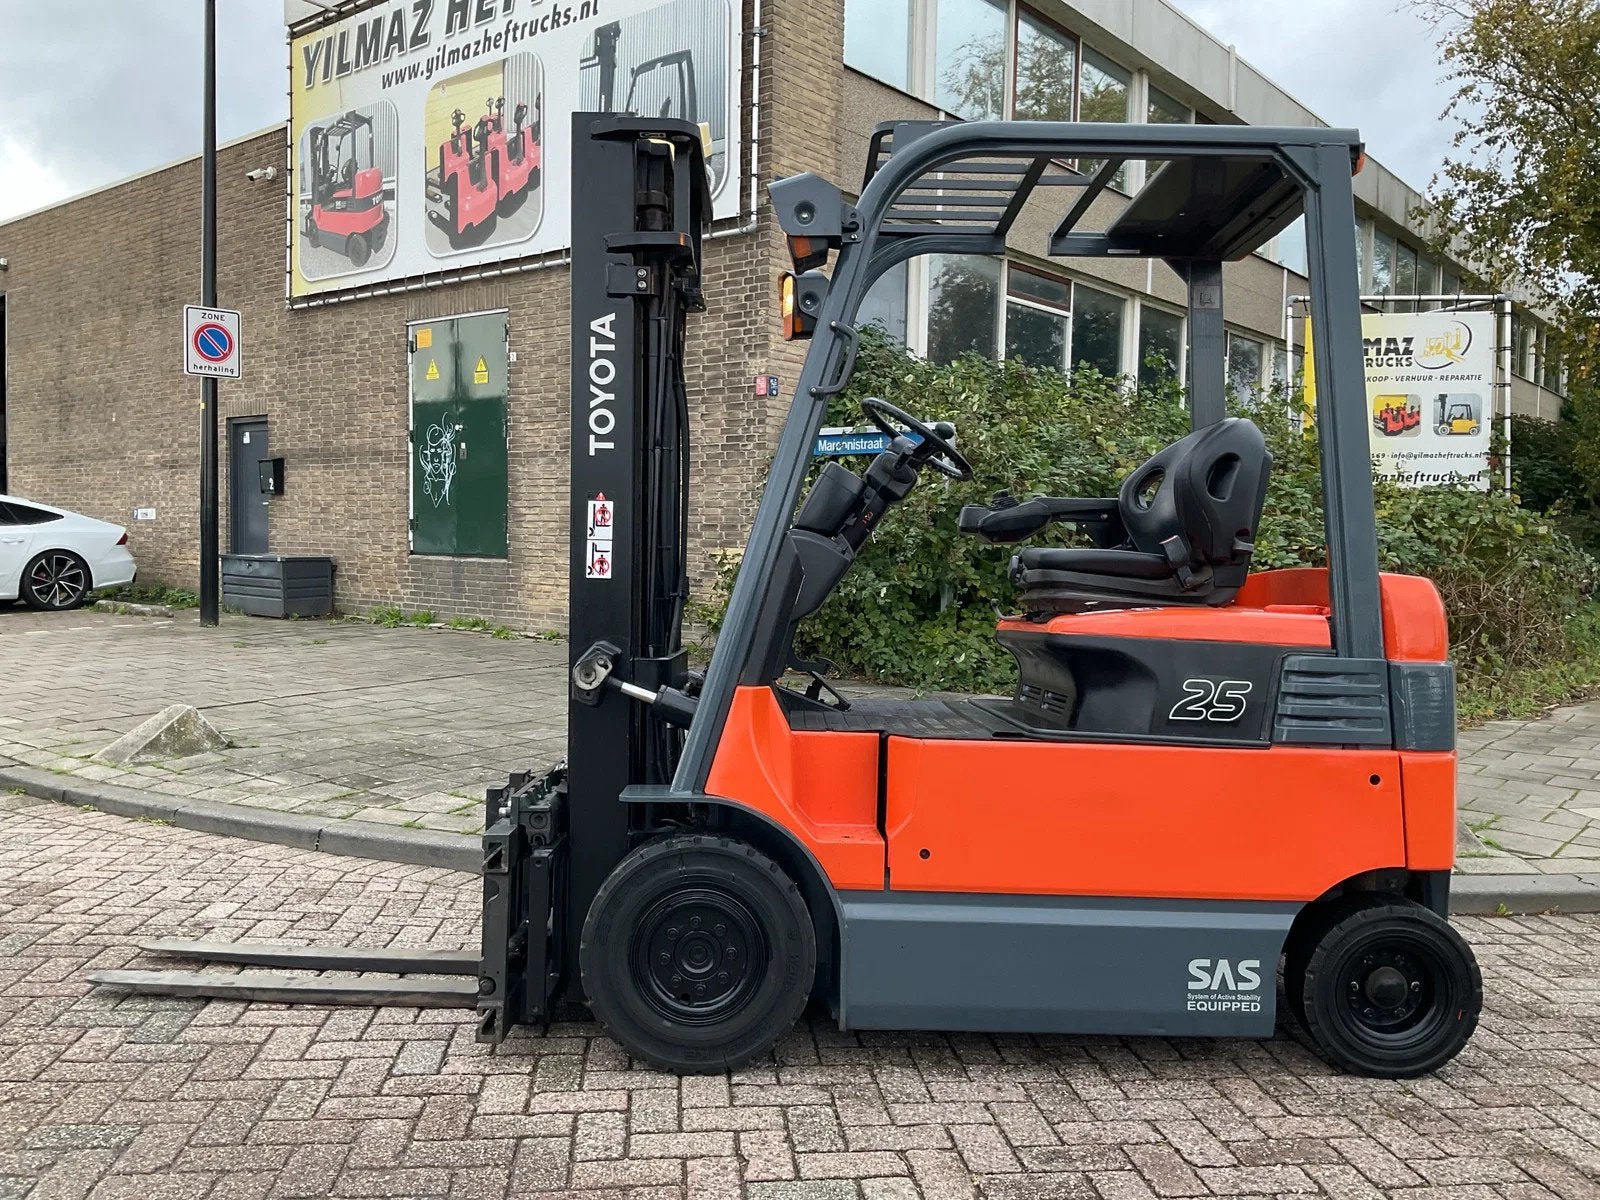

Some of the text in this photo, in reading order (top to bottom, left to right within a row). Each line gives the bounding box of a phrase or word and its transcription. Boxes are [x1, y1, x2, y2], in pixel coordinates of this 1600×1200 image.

[302, 0, 432, 88] YILMAZ
[381, 0, 599, 90] www.yilmazheftrucks.nl
[201, 312, 226, 321] ZONE
[1365, 356, 1413, 368] RUCKS
[193, 363, 235, 375] herhaling
[1395, 374, 1433, 382] VERHUUR
[1440, 373, 1482, 381] REPARATIE
[589, 312, 616, 456] TOYOTA
[1391, 451, 1482, 460] info@yilmazheftrucks.nl
[269, 477, 274, 490] 2
[1168, 679, 1253, 722] 25
[1187, 958, 1261, 990] SAS
[1187, 992, 1209, 1000] System
[1237, 994, 1261, 1002] Stability
[1187, 1001, 1261, 1012] EQUIPPED
